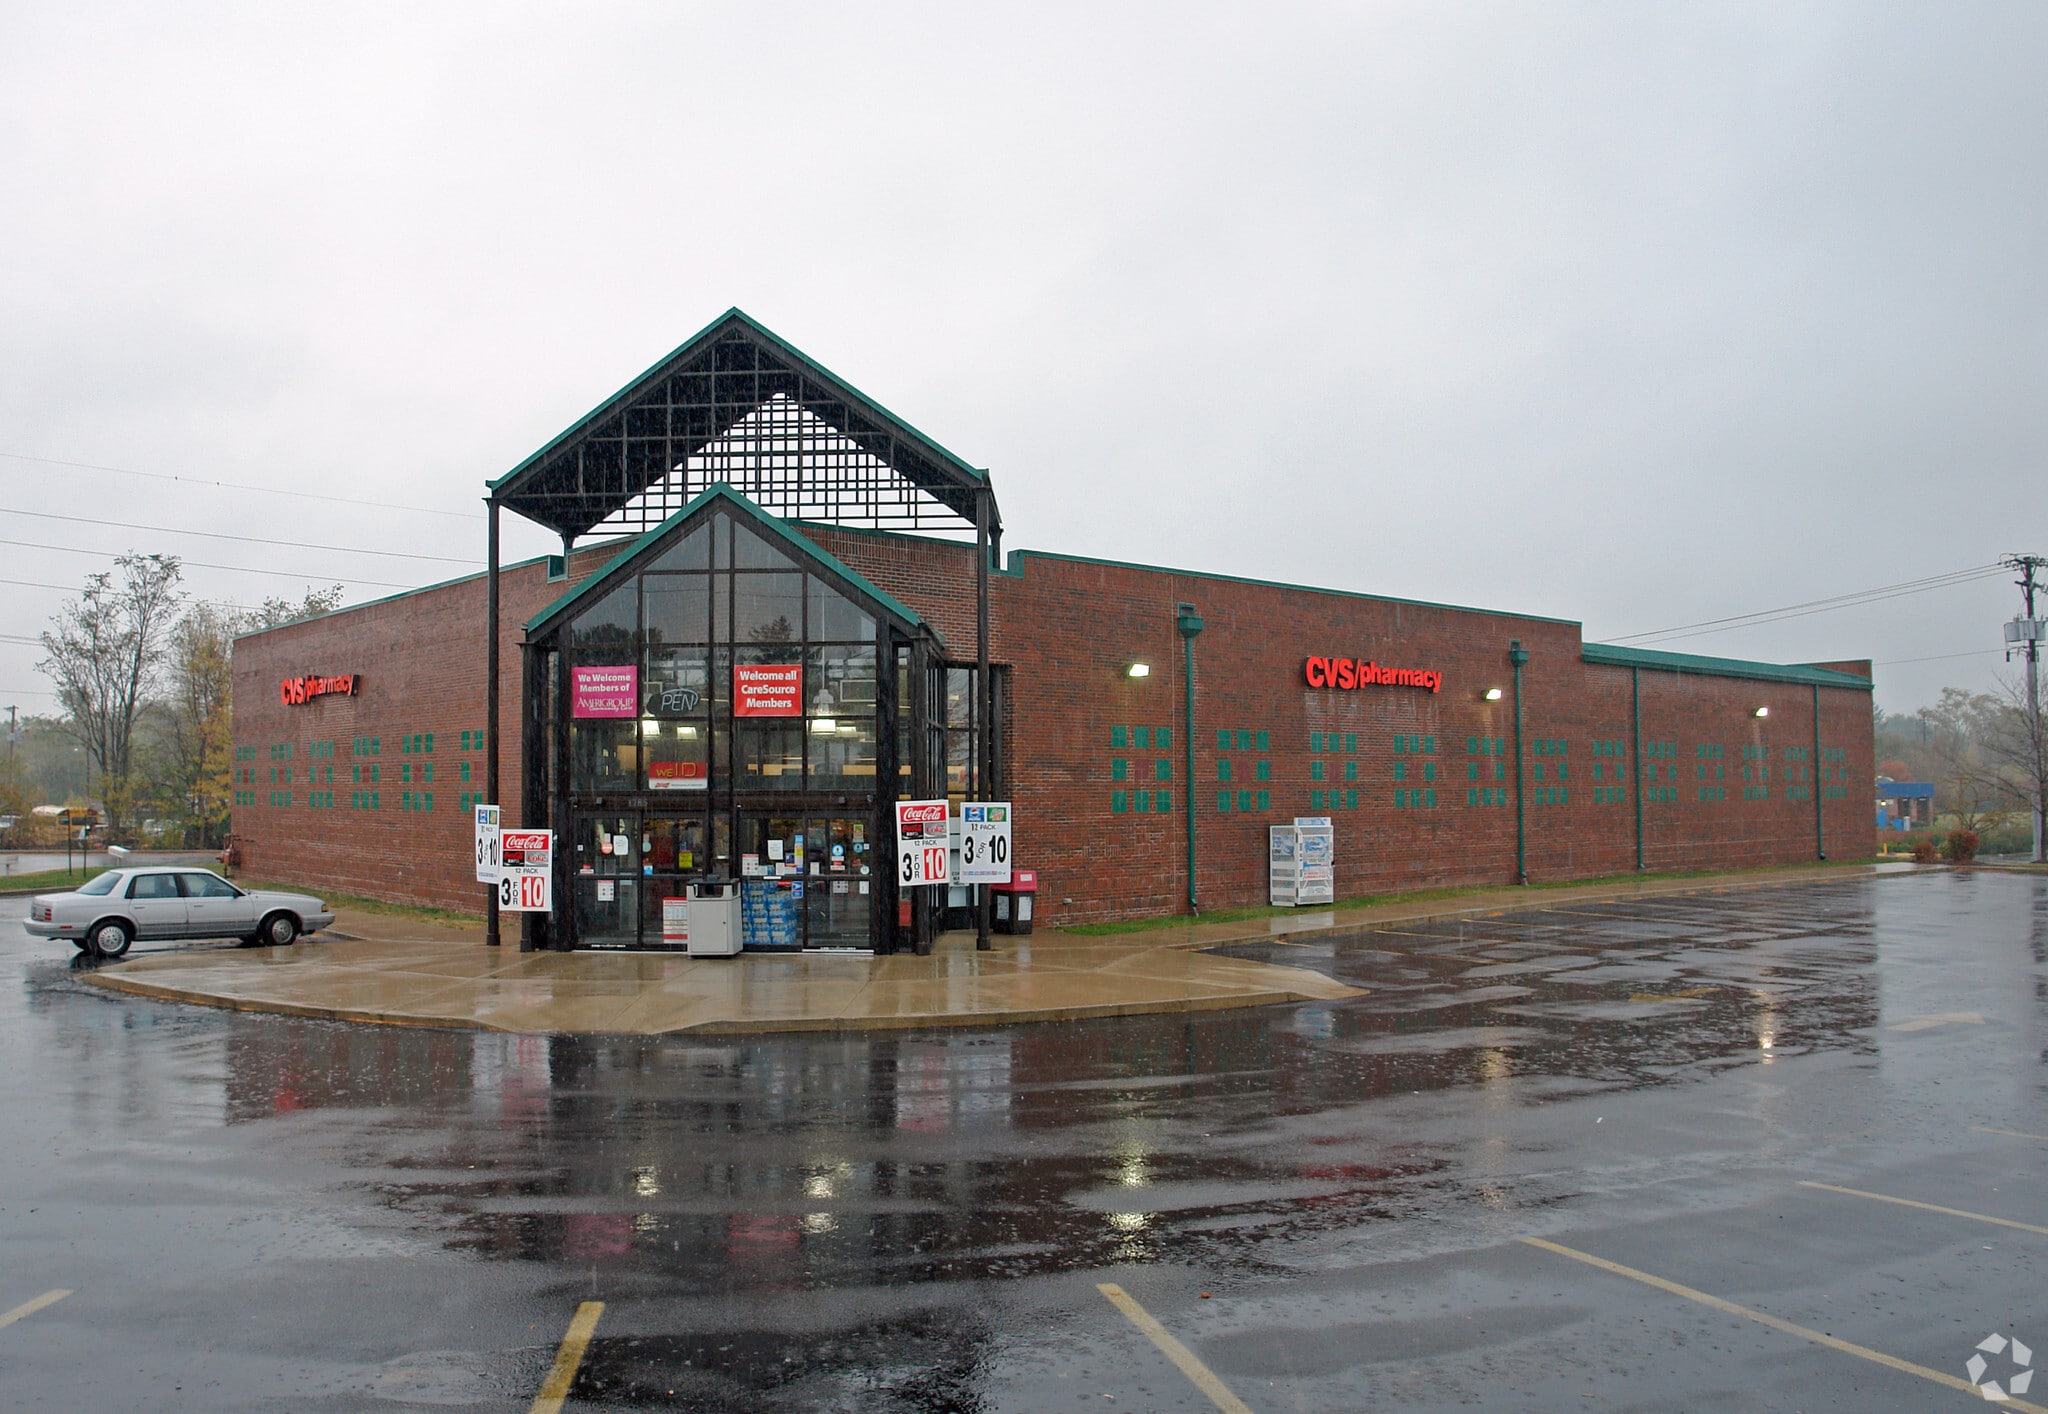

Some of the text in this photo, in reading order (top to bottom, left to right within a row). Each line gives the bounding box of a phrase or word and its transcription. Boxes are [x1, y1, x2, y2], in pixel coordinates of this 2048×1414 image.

[578, 673, 631, 682] We Welcome
[739, 670, 797, 681] Welcome all
[1306, 656, 1442, 693] CVS/pharmacy
[281, 675, 354, 705] CVS/pharmacy
[579, 683, 630, 692] Members of
[741, 684, 796, 694] CareSource
[746, 697, 792, 708] Members
[971, 823, 978, 831] 12
[478, 838, 483, 864] 3
[489, 838, 498, 865] 10
[964, 835, 1007, 864] 3 FOR 10
[902, 853, 912, 882] 3
[925, 848, 946, 879] 10
[501, 877, 511, 906] 3
[523, 877, 544, 907] 10
